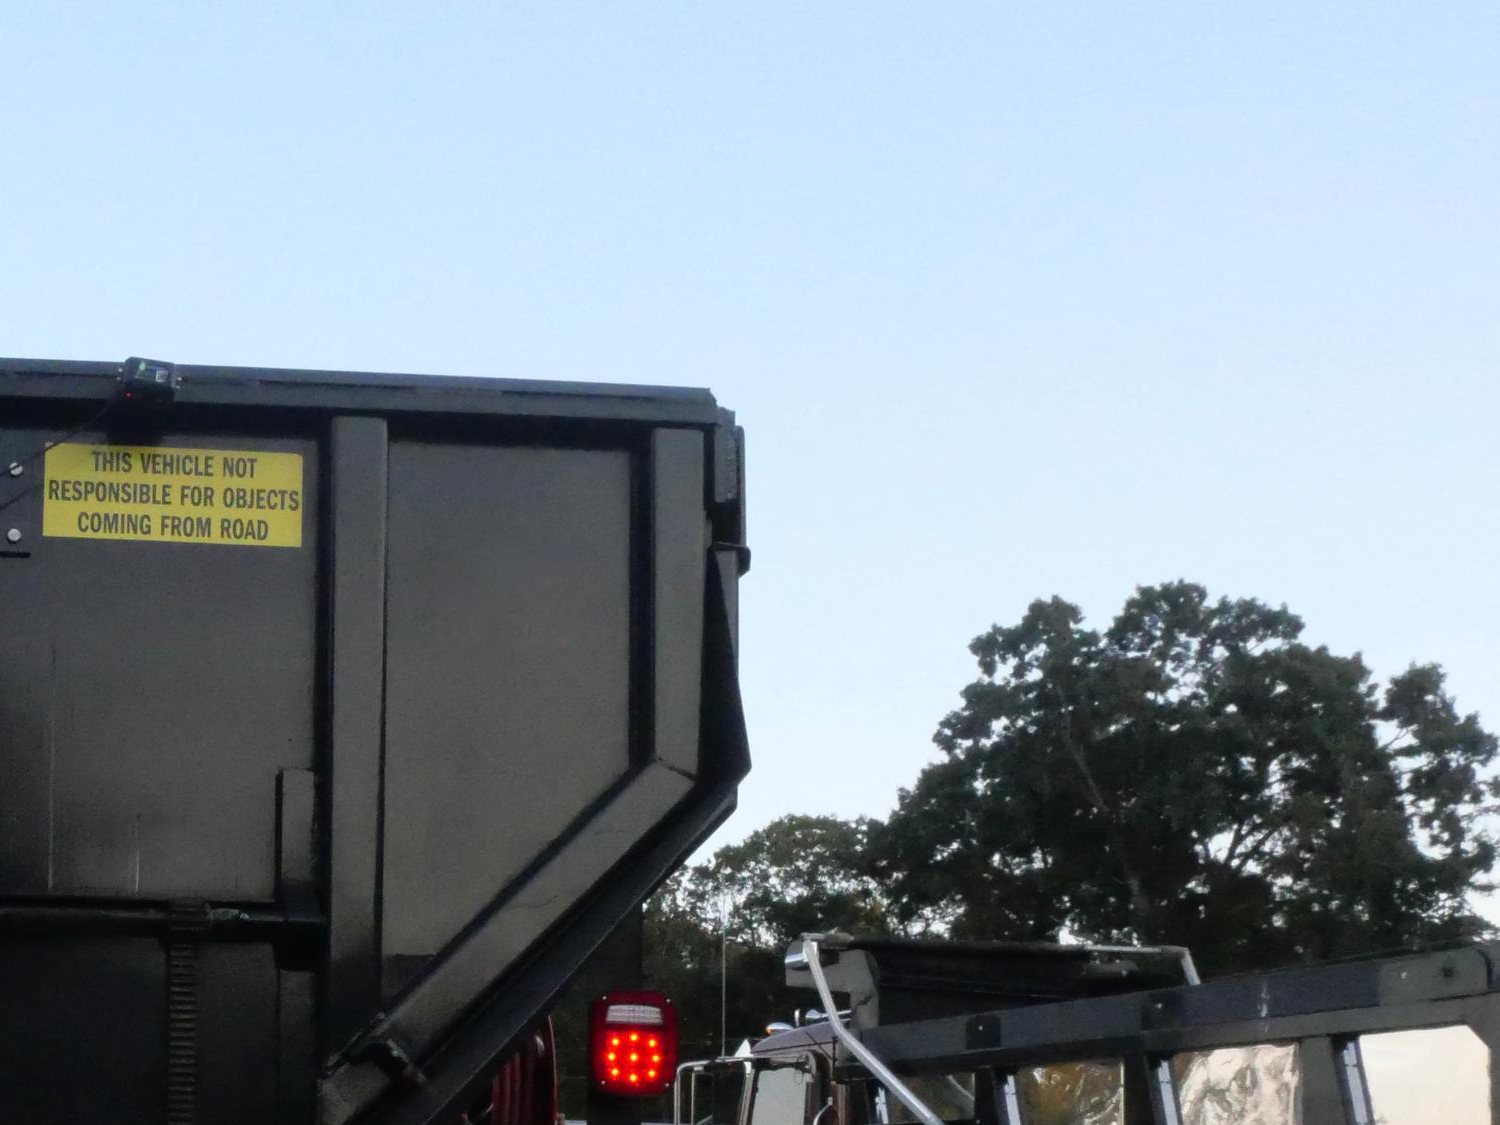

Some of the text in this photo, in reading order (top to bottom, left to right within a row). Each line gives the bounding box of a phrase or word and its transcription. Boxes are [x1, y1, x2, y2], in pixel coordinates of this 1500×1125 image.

[93, 451, 258, 478] THIS VEHICLE NOT
[49, 480, 299, 511] RESPONSIBLE FOR OBJECTS
[78, 512, 269, 540] COMING FROM ROAD
